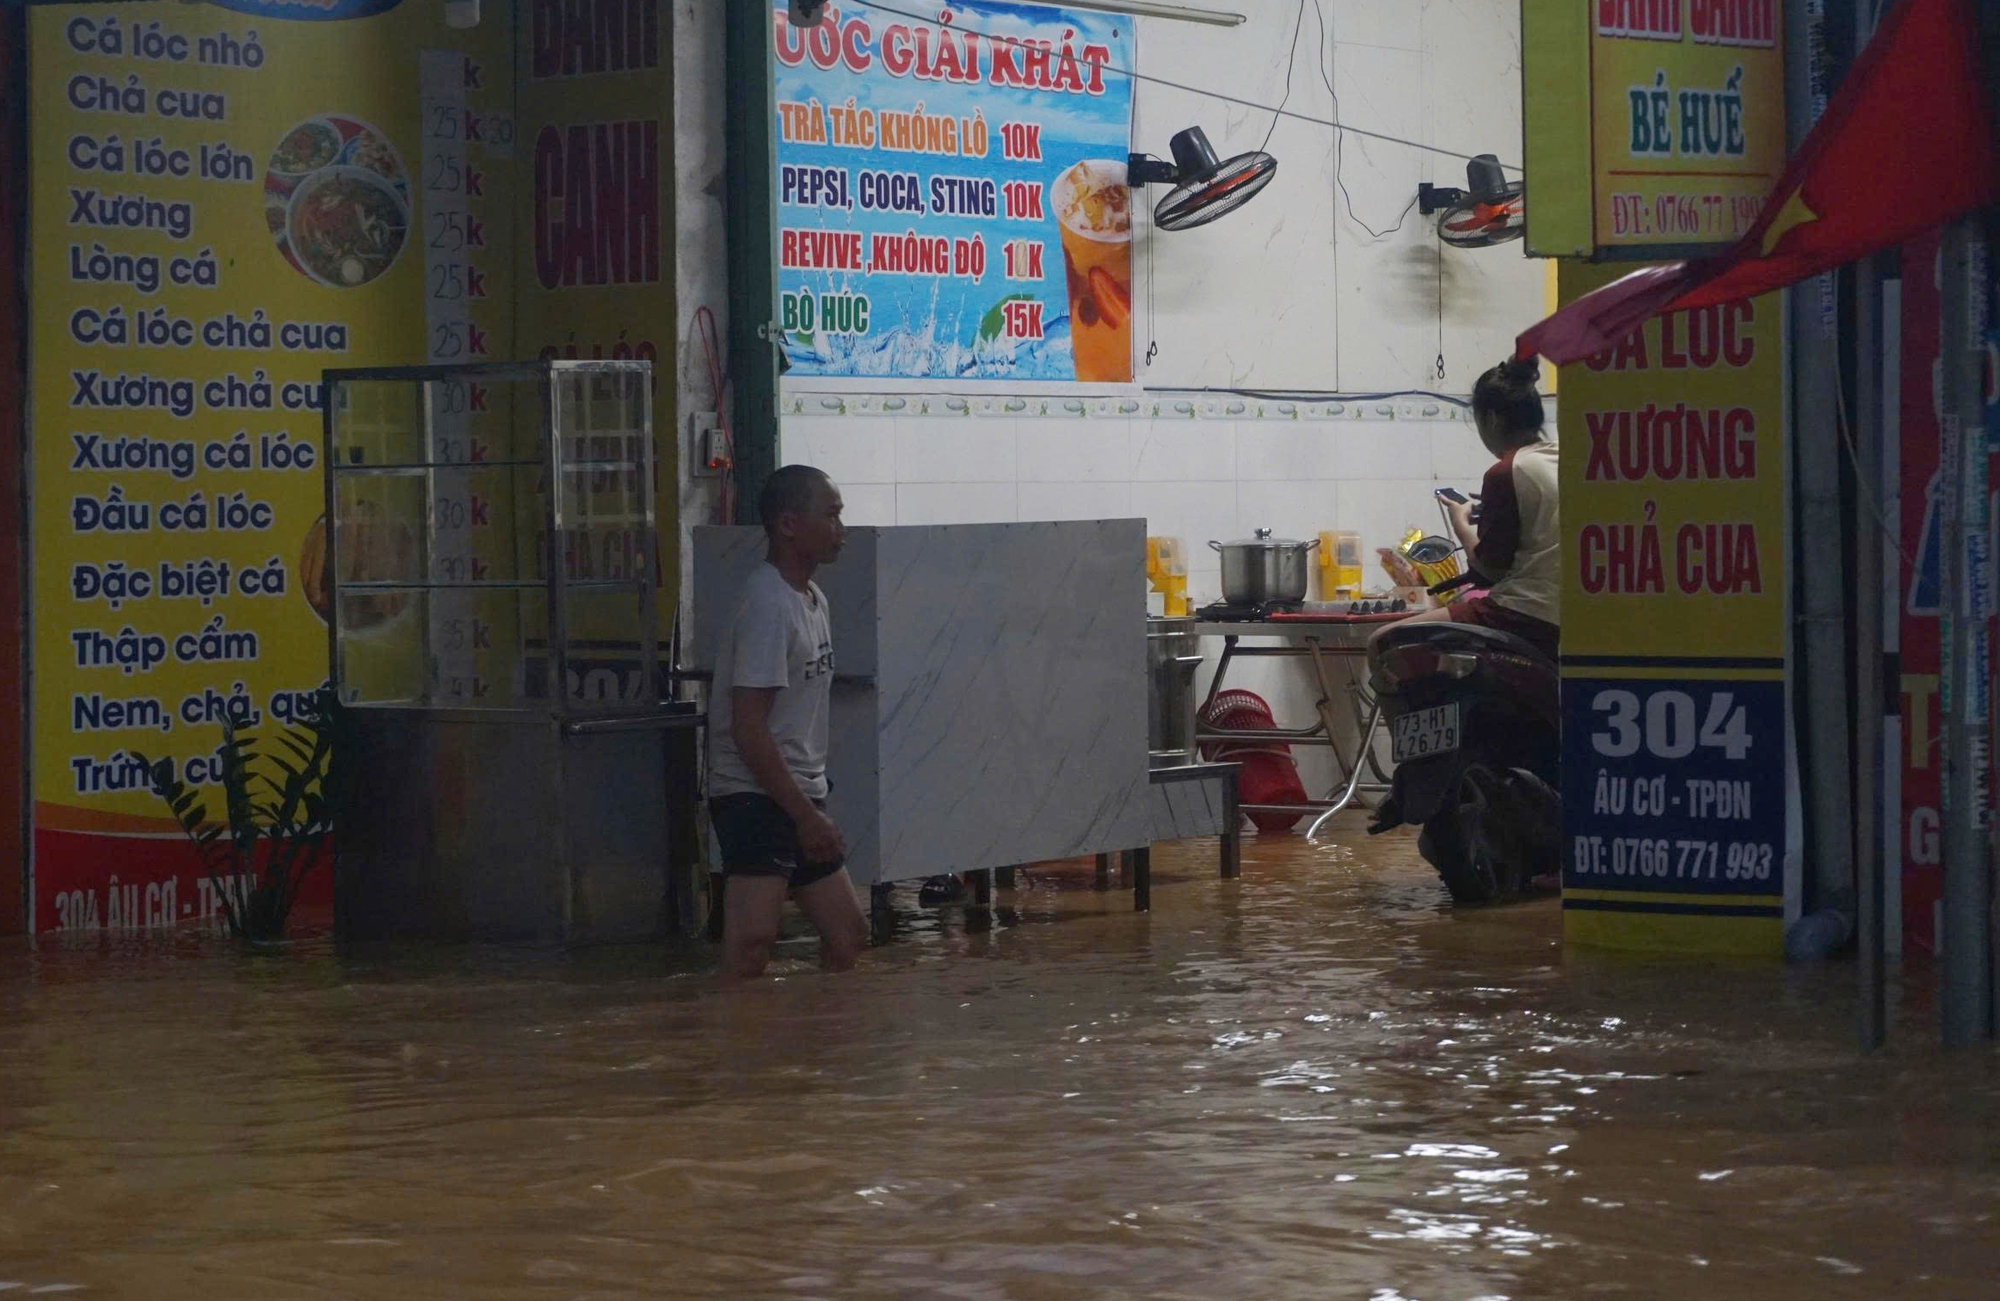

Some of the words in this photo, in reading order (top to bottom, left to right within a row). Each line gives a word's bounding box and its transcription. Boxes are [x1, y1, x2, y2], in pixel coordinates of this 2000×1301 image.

[67, 17, 122, 54] Cá
[133, 22, 188, 60] lóc
[199, 30, 264, 67] nhỏ
[881, 10, 981, 81] GIẢI
[989, 29, 1110, 94] KHÁT
[68, 74, 146, 114] Chả
[156, 90, 225, 120] cua
[1630, 72, 1671, 152] BÉ
[1679, 66, 1743, 154] HUẾ
[780, 99, 826, 143] TRÀ
[830, 97, 874, 147] TẮC
[881, 103, 955, 153] KHỔNG
[962, 107, 987, 157] LỒ
[1001, 123, 1041, 160] 10K
[68, 135, 123, 171] Cá
[135, 138, 190, 176] lóc
[201, 143, 252, 180] lớn
[70, 190, 190, 238] Xương
[535, 119, 658, 289] CANH
[783, 167, 852, 211] PEPSI,
[860, 173, 925, 215] COCA,
[931, 178, 995, 216] STING
[1003, 184, 1043, 219] 10K
[1656, 195, 1699, 234] 0766
[72, 244, 159, 292] Lòng
[170, 249, 216, 284] cá
[783, 231, 861, 269] REVIVE
[954, 232, 985, 282] ĐỘ
[71, 307, 127, 344] Cá
[138, 308, 193, 345] lóc
[203, 310, 271, 347] chả
[280, 324, 346, 349] cua
[783, 289, 816, 332] BÒ
[822, 292, 868, 333] HÚC
[1003, 302, 1043, 338] 15K
[71, 371, 193, 416] Xương
[204, 371, 271, 408] chả
[72, 435, 193, 477] Xương
[204, 433, 250, 468] cá
[261, 433, 314, 468] lóc
[1584, 403, 1756, 481] XƯƠNG
[73, 485, 149, 530] Đầu
[159, 492, 206, 528] cá
[218, 492, 272, 528] lóc
[1580, 500, 1665, 593] CHẢ
[1676, 523, 1761, 593] CUA
[73, 563, 151, 607] Đặc
[161, 560, 229, 605] biệt
[239, 557, 284, 593] cá
[73, 627, 165, 673] Thập
[176, 616, 256, 659] cẩm
[74, 696, 170, 730] Nem,
[182, 684, 260, 724] chả,
[1591, 689, 1752, 760] 304
[1594, 769, 1626, 816] ÂU
[1633, 775, 1666, 816] CƠ
[1686, 779, 1750, 820] TPĐN
[1574, 836, 1607, 875] ĐT:
[1612, 837, 1669, 878] 0766
[1676, 841, 1718, 879] 771
[1726, 843, 1773, 880] 993
